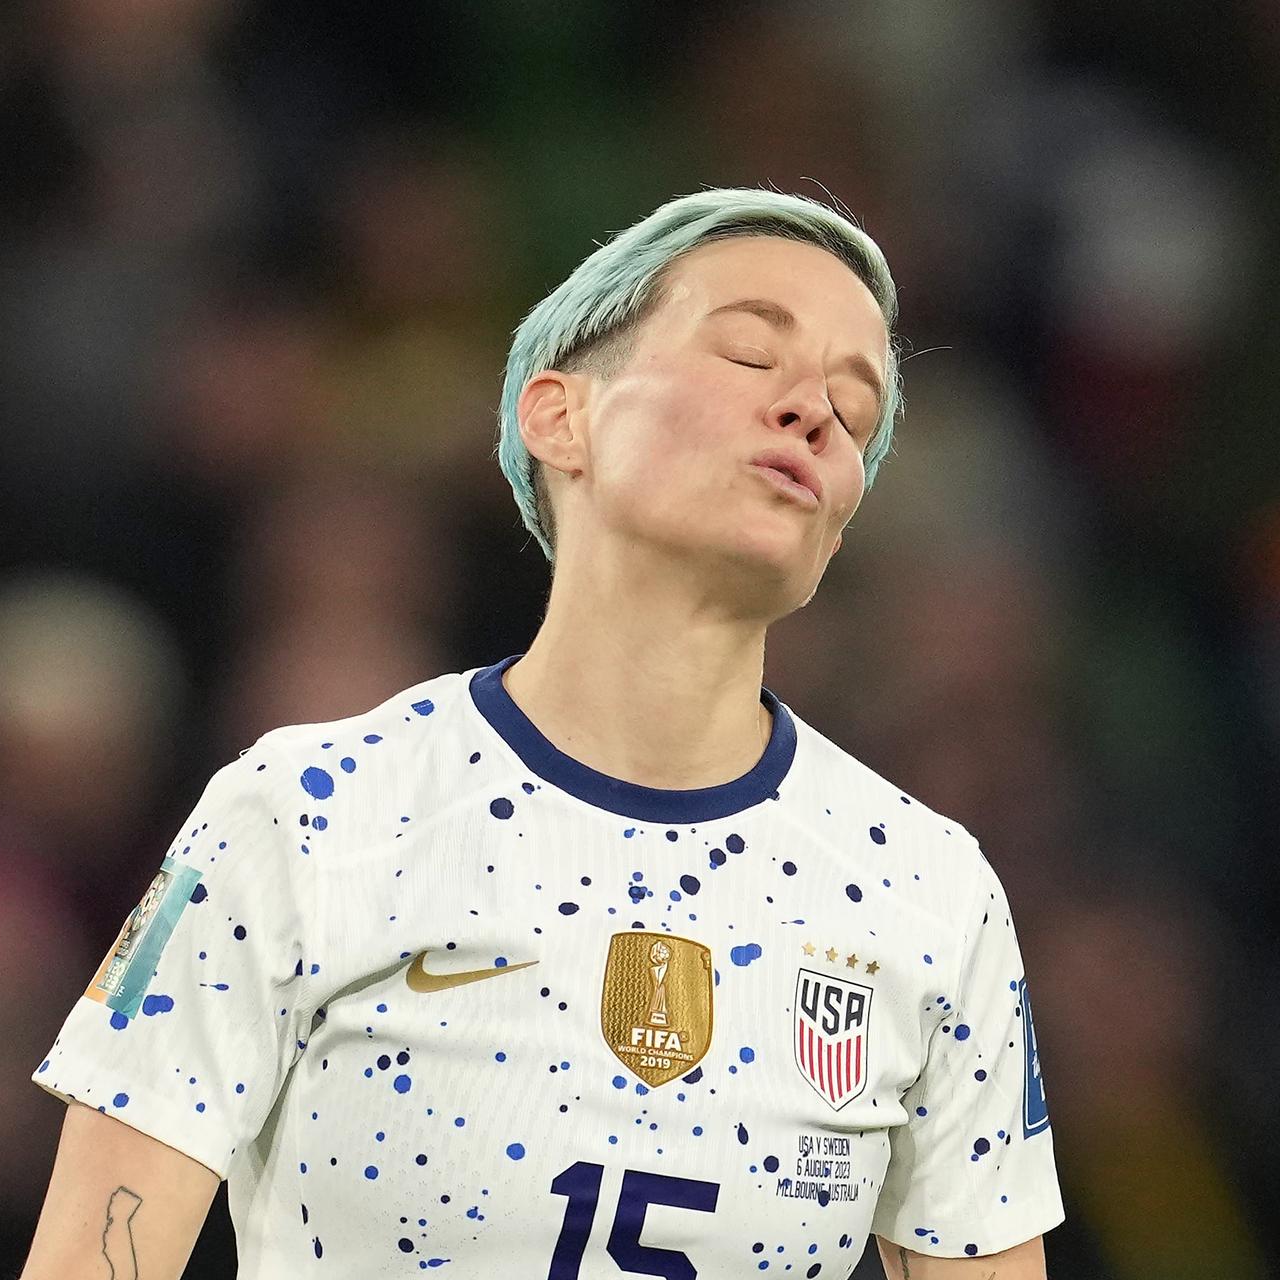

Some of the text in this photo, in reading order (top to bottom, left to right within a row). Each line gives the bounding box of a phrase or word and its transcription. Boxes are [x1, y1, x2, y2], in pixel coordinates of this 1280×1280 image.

[801, 978, 866, 1036] USA
[631, 1027, 682, 1051] FIFA
[618, 1045, 694, 1061] WORLD CHAMPIONS
[640, 1056, 671, 1069] 2019
[799, 1135, 850, 1156] USA V SWEDEN
[796, 1158, 851, 1179] 6 AUGUST 2023
